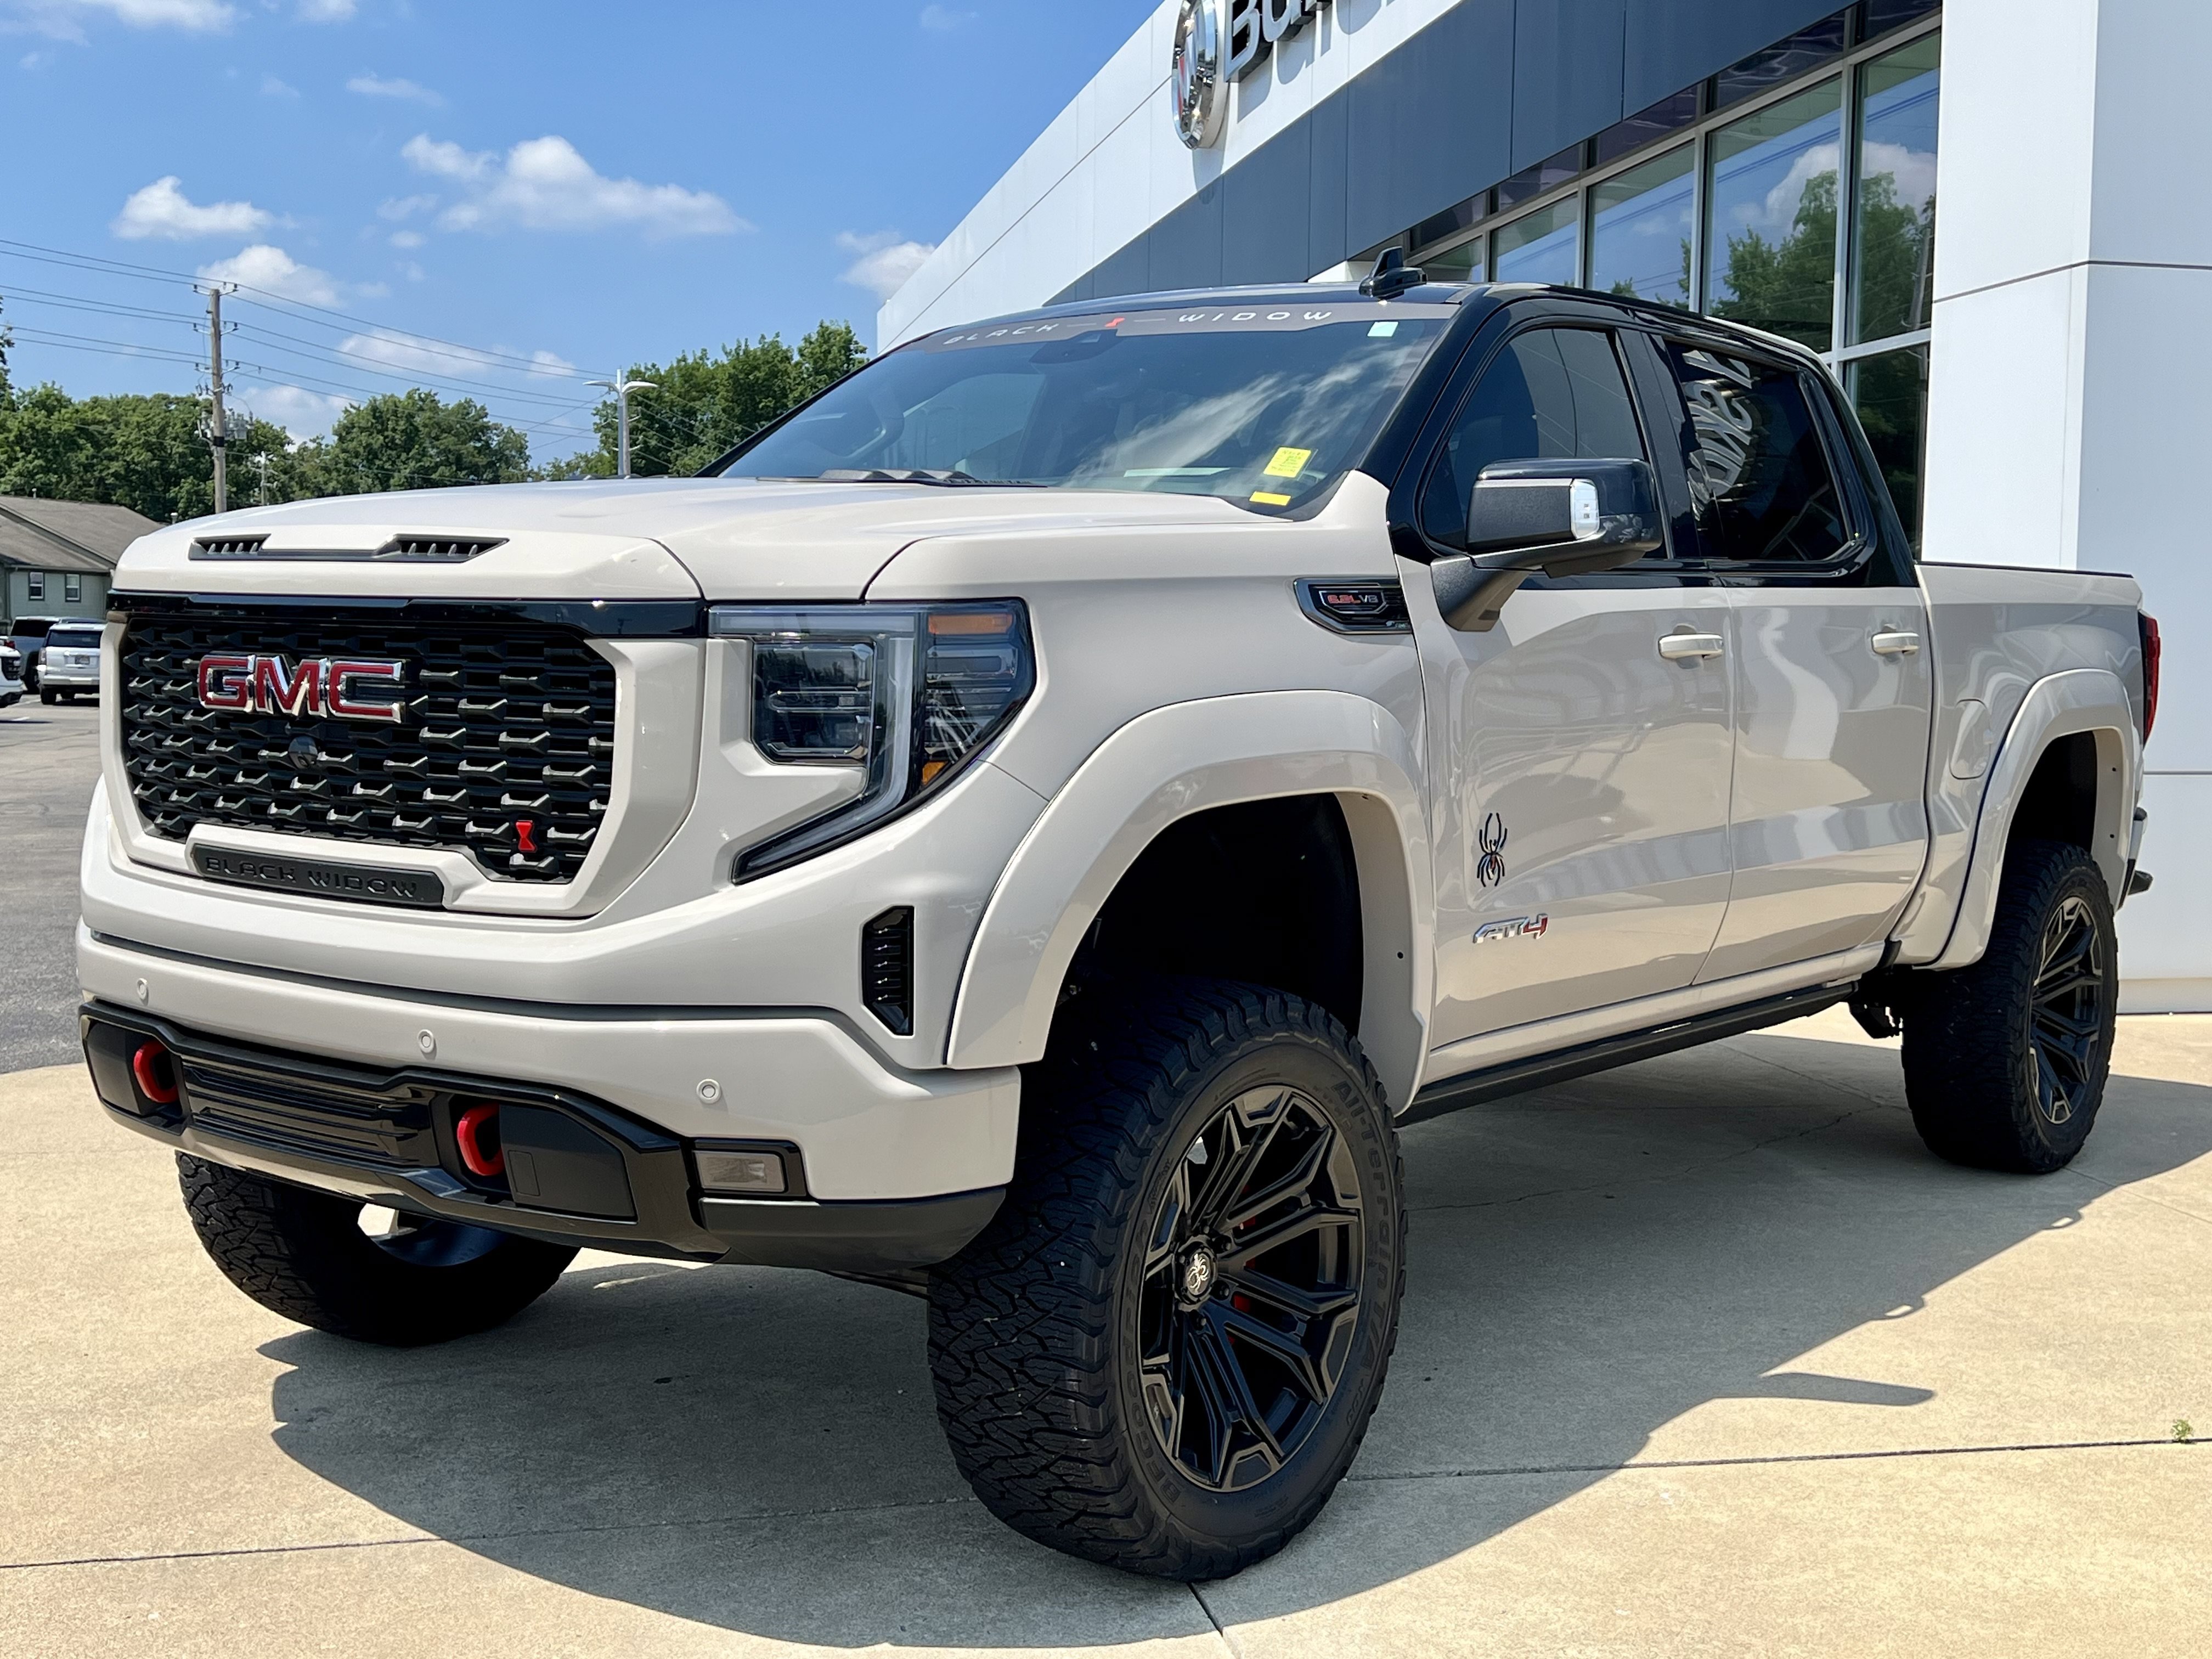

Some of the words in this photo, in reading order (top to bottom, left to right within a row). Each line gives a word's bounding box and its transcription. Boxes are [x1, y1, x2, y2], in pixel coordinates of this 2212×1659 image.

[942, 323, 1060, 345] BLACK
[1178, 311, 1333, 323] WIDOW
[198, 653, 404, 724] GMC
[206, 857, 296, 882] BLACK
[308, 864, 416, 899] WIDOW
[1472, 913, 1548, 944] AT4
